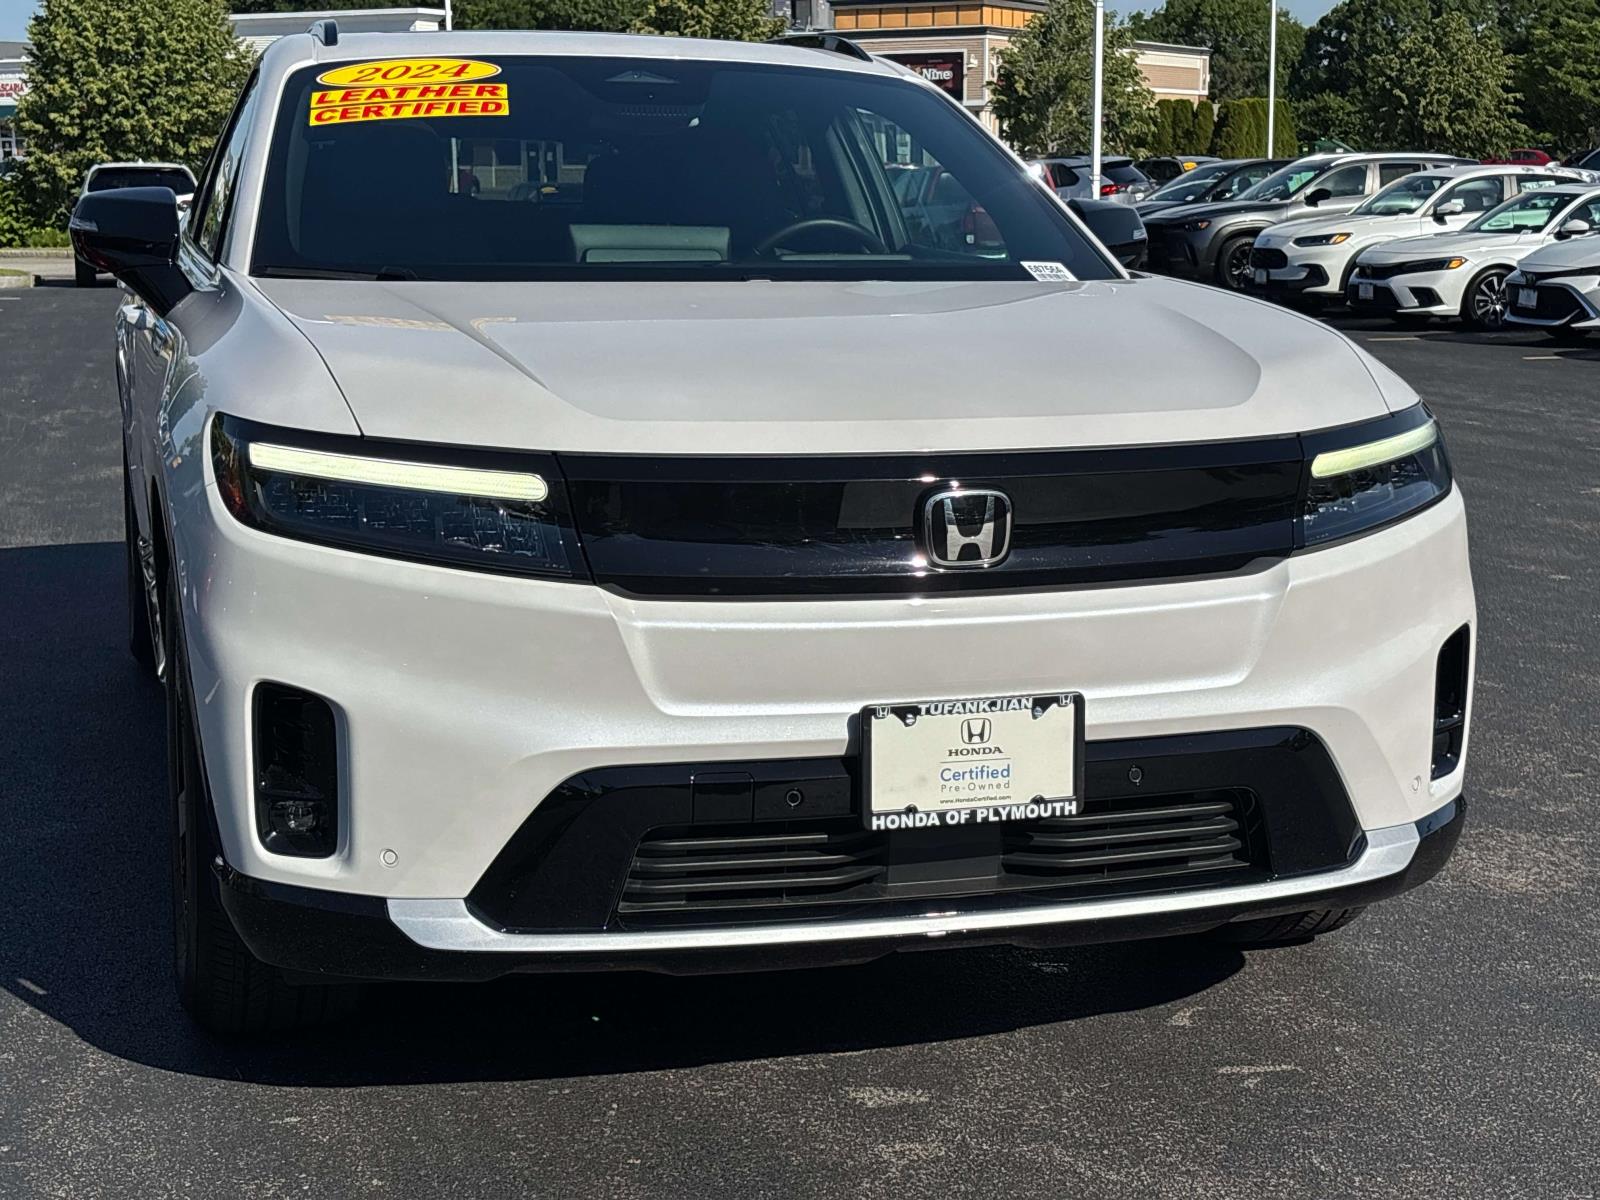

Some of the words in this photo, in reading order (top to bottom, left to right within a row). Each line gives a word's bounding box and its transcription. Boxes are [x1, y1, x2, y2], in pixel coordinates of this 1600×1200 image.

[349, 63, 472, 84] 2024
[921, 68, 953, 80] Nine
[315, 85, 501, 105] LEATHER
[314, 101, 505, 123] CERTIFIED
[918, 697, 1033, 716] TUFANKJIAN
[947, 746, 1004, 757] HONDA
[940, 763, 1011, 782] Certified
[940, 780, 1010, 792] Pre-Owned
[939, 795, 1012, 804] www.HondaCertified.com
[871, 810, 941, 831] HONDA
[945, 808, 975, 825] OF
[976, 801, 1077, 823] PLYMOUTH
